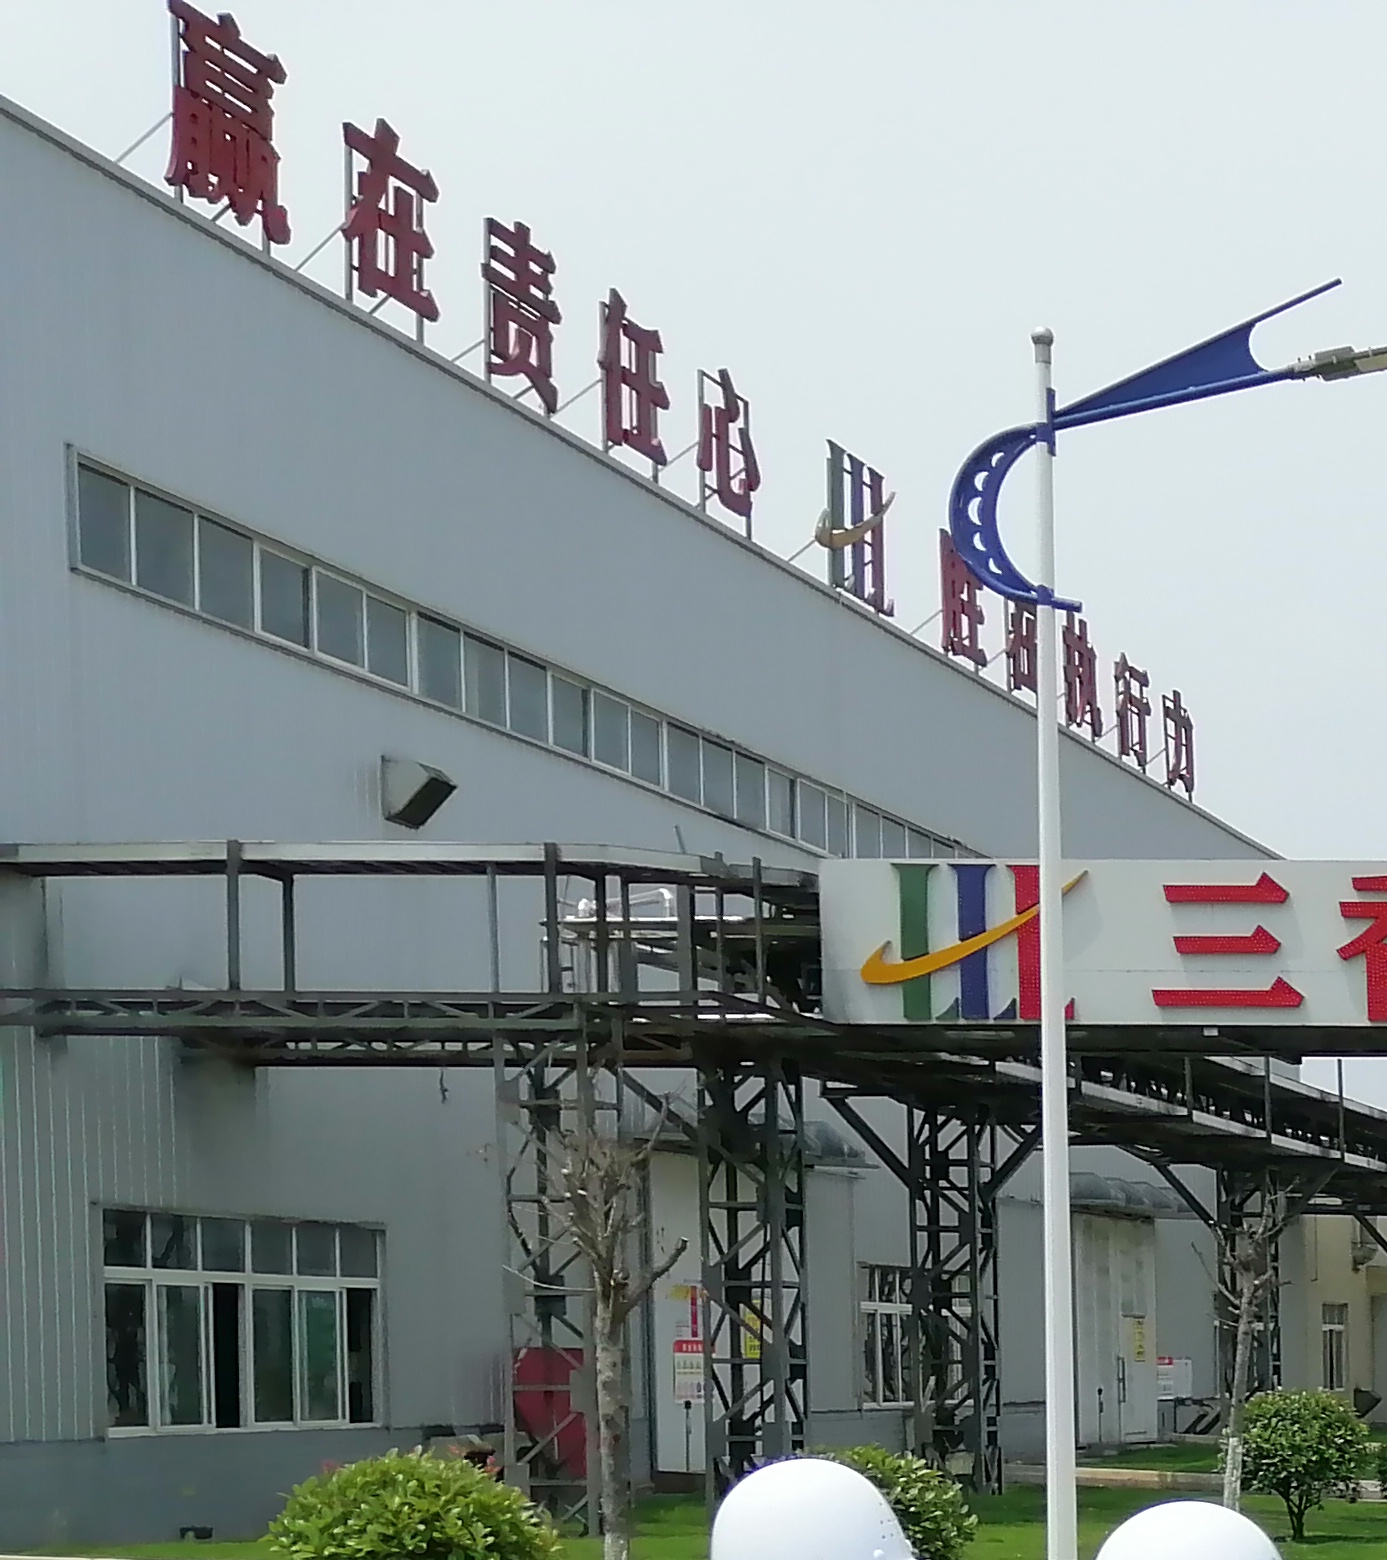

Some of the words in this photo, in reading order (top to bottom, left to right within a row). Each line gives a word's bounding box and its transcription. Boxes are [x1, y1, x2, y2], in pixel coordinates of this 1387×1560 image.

[167, 0, 761, 518] 赢在责任心
